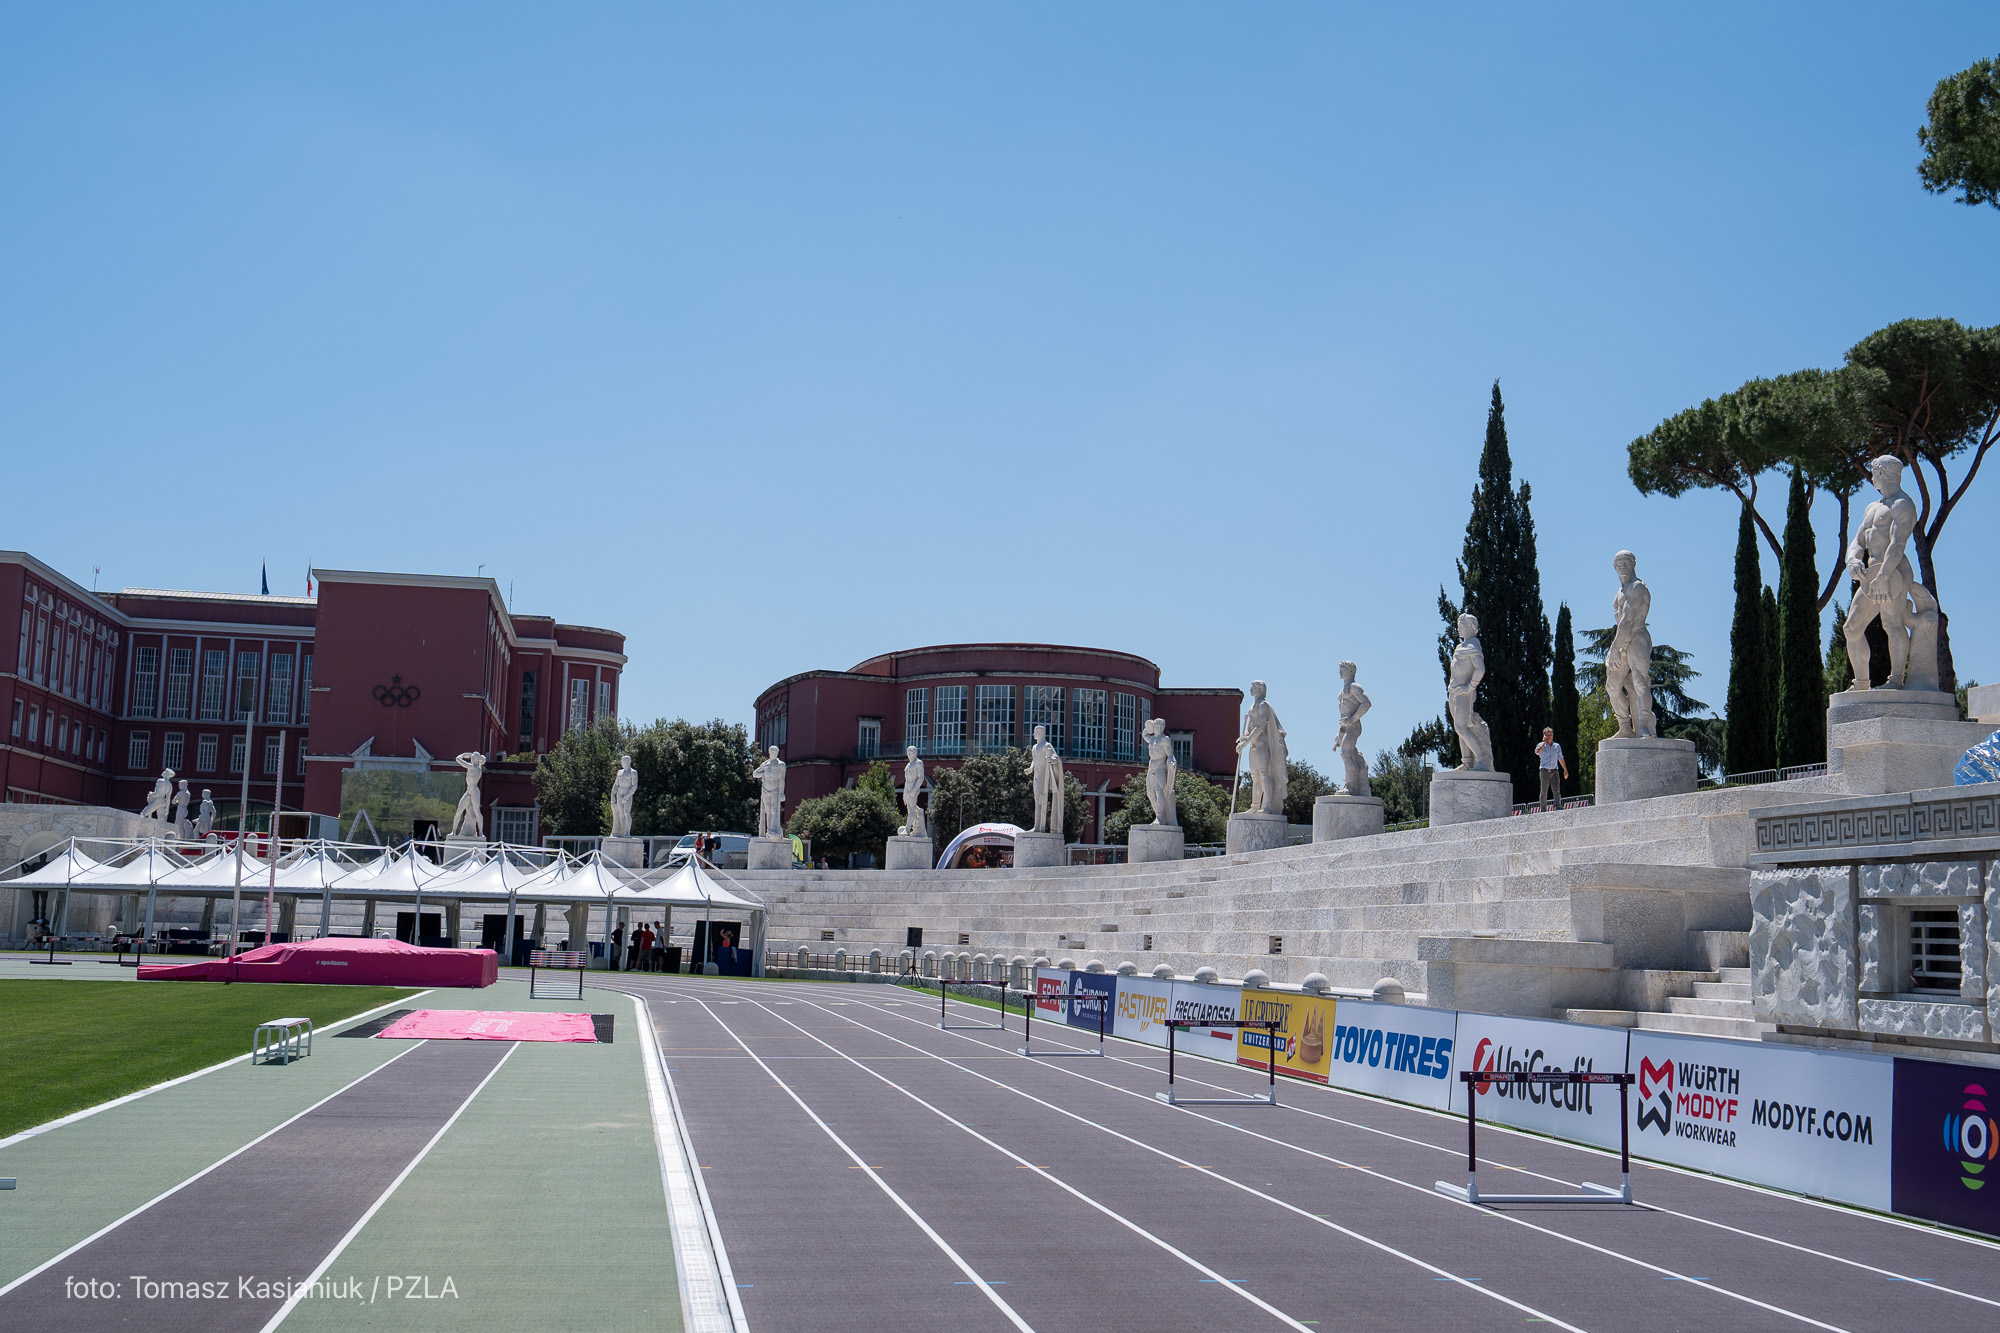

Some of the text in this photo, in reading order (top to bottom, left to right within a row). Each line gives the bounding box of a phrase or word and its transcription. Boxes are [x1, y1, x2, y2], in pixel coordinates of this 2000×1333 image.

[1041, 983, 1060, 1006] SPAR
[1118, 992, 1168, 1025] FASTWEB
[1174, 1000, 1236, 1021] FRECCIAROSSA
[1244, 1033, 1285, 1050] SWITZERAND
[1334, 1025, 1453, 1080] TOYO TIRES
[1496, 1045, 1593, 1115] UniCredit
[1678, 1062, 1740, 1095] WÜRTH
[1676, 1092, 1739, 1123] MODYF
[1752, 1099, 1873, 1146] MODYF.COM
[1675, 1120, 1737, 1148] WORKWEAR
